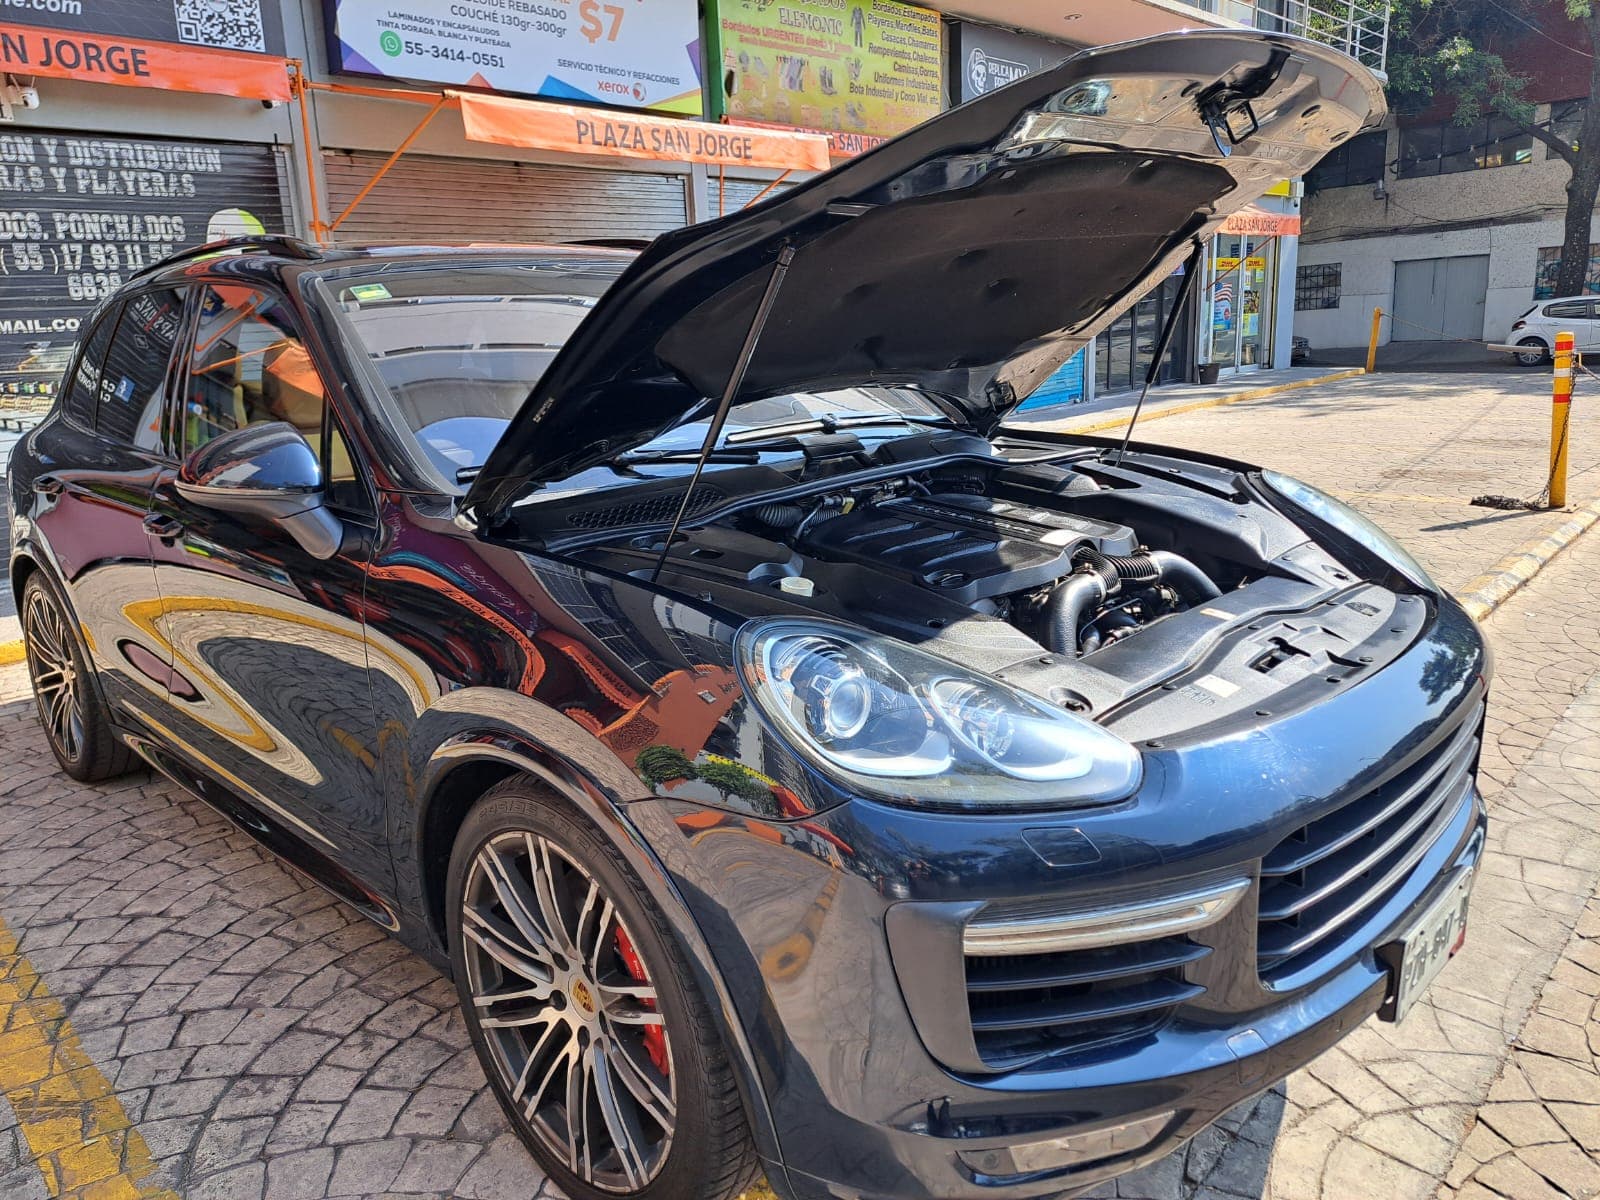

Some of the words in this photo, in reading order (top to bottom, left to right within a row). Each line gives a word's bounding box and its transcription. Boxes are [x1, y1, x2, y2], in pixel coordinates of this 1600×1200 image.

[388, 10, 435, 27] LAMINADOS
[436, 18, 442, 27] Y
[450, 4, 499, 23] COUCHÉ
[501, 14, 567, 38] 130gr-300gr
[508, 0, 567, 20] REBASADO
[579, 0, 624, 44] $7
[779, 8, 843, 36] ELEMONIC
[376, 19, 401, 31] TINTA
[402, 23, 436, 37] DORADA,
[438, 30, 468, 42] BLANCA
[468, 34, 474, 43] Y
[475, 35, 511, 49] PLATEADA
[0, 33, 29, 64] N
[40, 37, 151, 77] JORGE
[404, 41, 505, 69] 55-3414-0551
[557, 58, 593, 72] SERVICIO
[594, 64, 626, 78] TÉCNICO
[633, 71, 680, 86] REFACCIONES
[597, 80, 630, 96] xerox
[866, 85, 895, 100] Industrial
[900, 91, 916, 102] Cono
[576, 119, 645, 150] PLAZA
[650, 127, 690, 154] SAN
[696, 133, 753, 160] JORGE
[839, 133, 864, 153] SAN
[0, 136, 35, 163] ON
[40, 138, 58, 165] Y
[65, 140, 222, 173] DISTRIBUCION
[50, 167, 67, 194] Y
[74, 168, 196, 198] PLAYERAS
[52, 212, 187, 243] PONCHADOS
[1227, 216, 1247, 231] PLAZA
[1247, 218, 1260, 232] SAN
[1260, 218, 1279, 232] JORGE
[61, 243, 83, 271] 17
[90, 243, 120, 271] 93
[124, 243, 145, 271] 11
[0, 317, 83, 334] MAIL.CO
